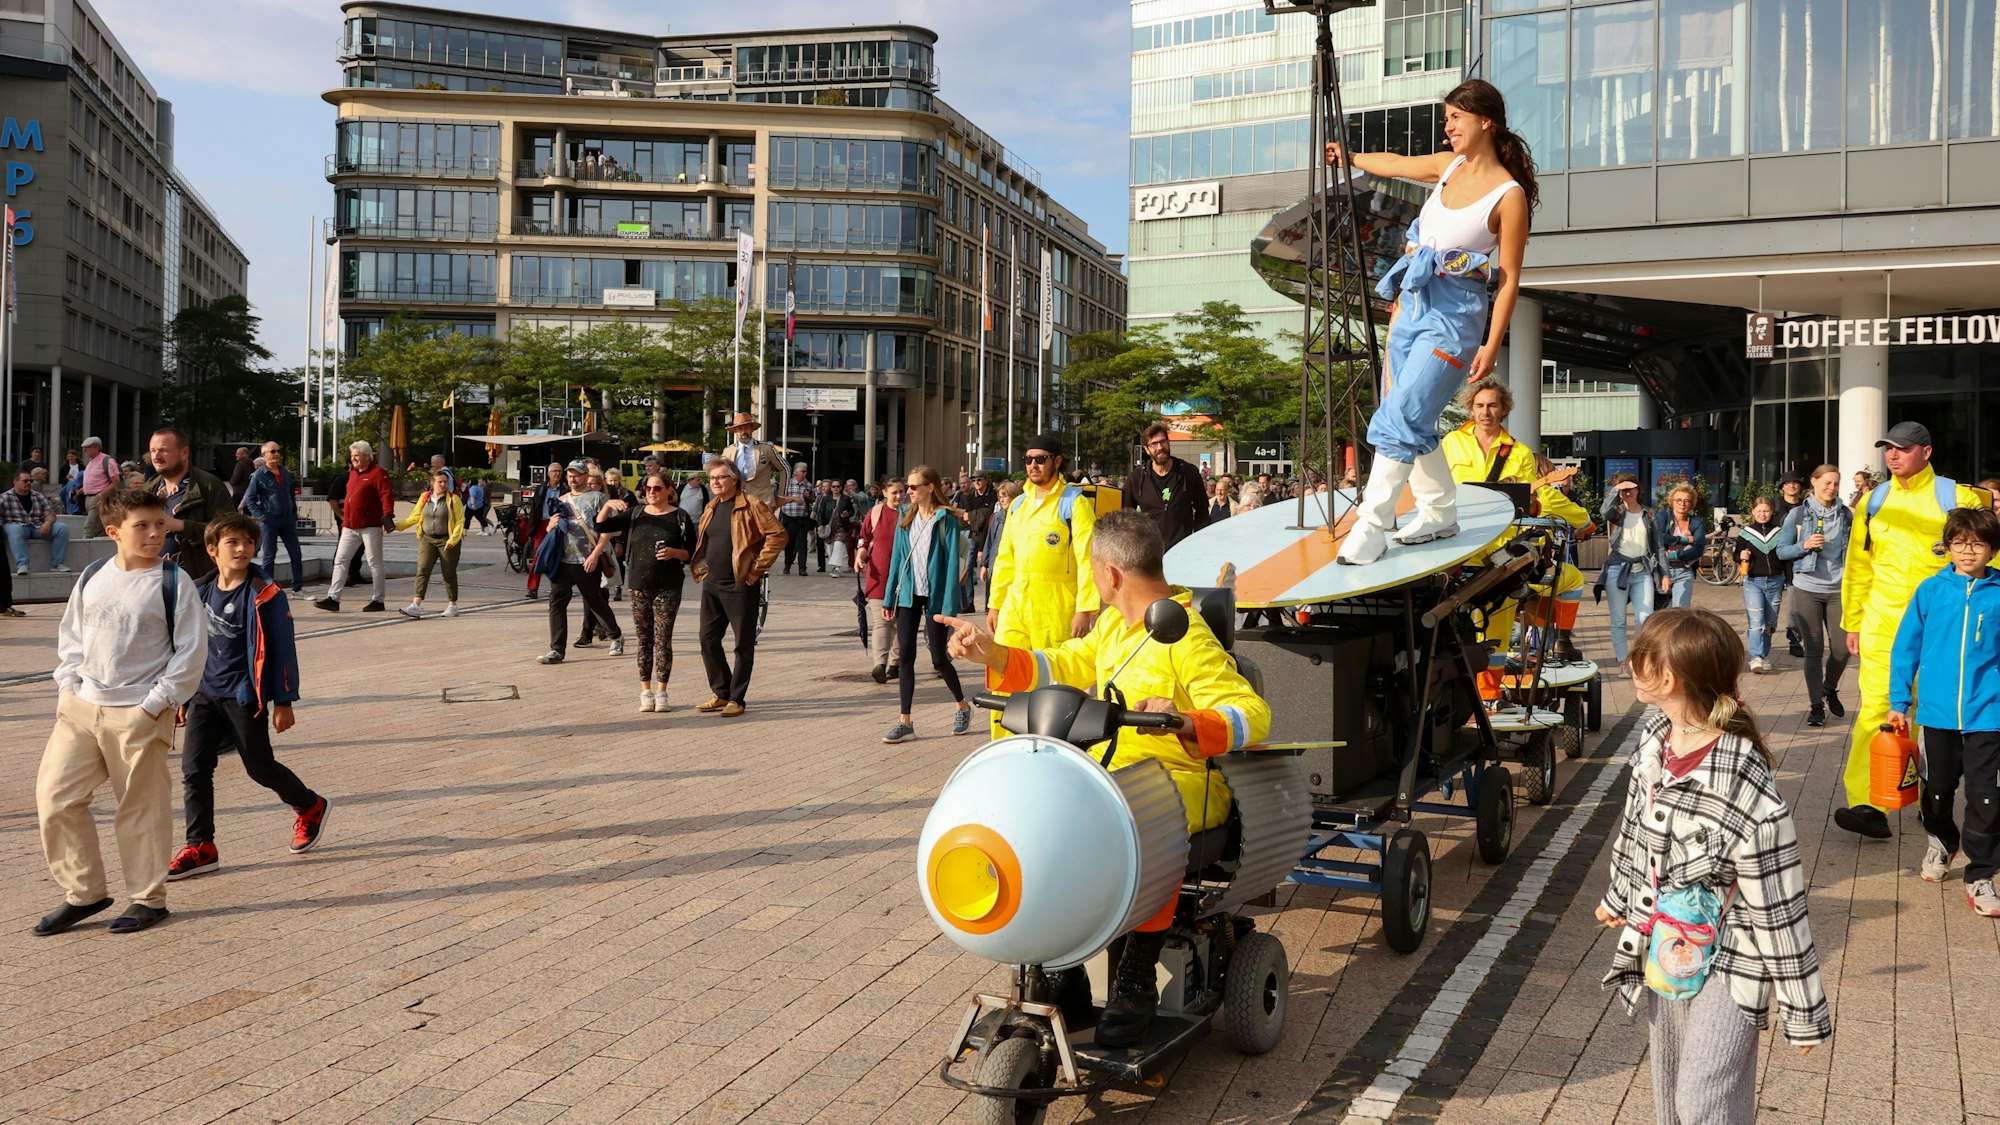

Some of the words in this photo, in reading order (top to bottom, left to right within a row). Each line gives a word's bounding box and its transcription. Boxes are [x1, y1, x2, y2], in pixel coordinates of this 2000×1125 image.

[1782, 318, 1890, 349] COFFEE
[1746, 345, 1773, 353] COFFEE
[1254, 446, 1277, 457] 4a-e
